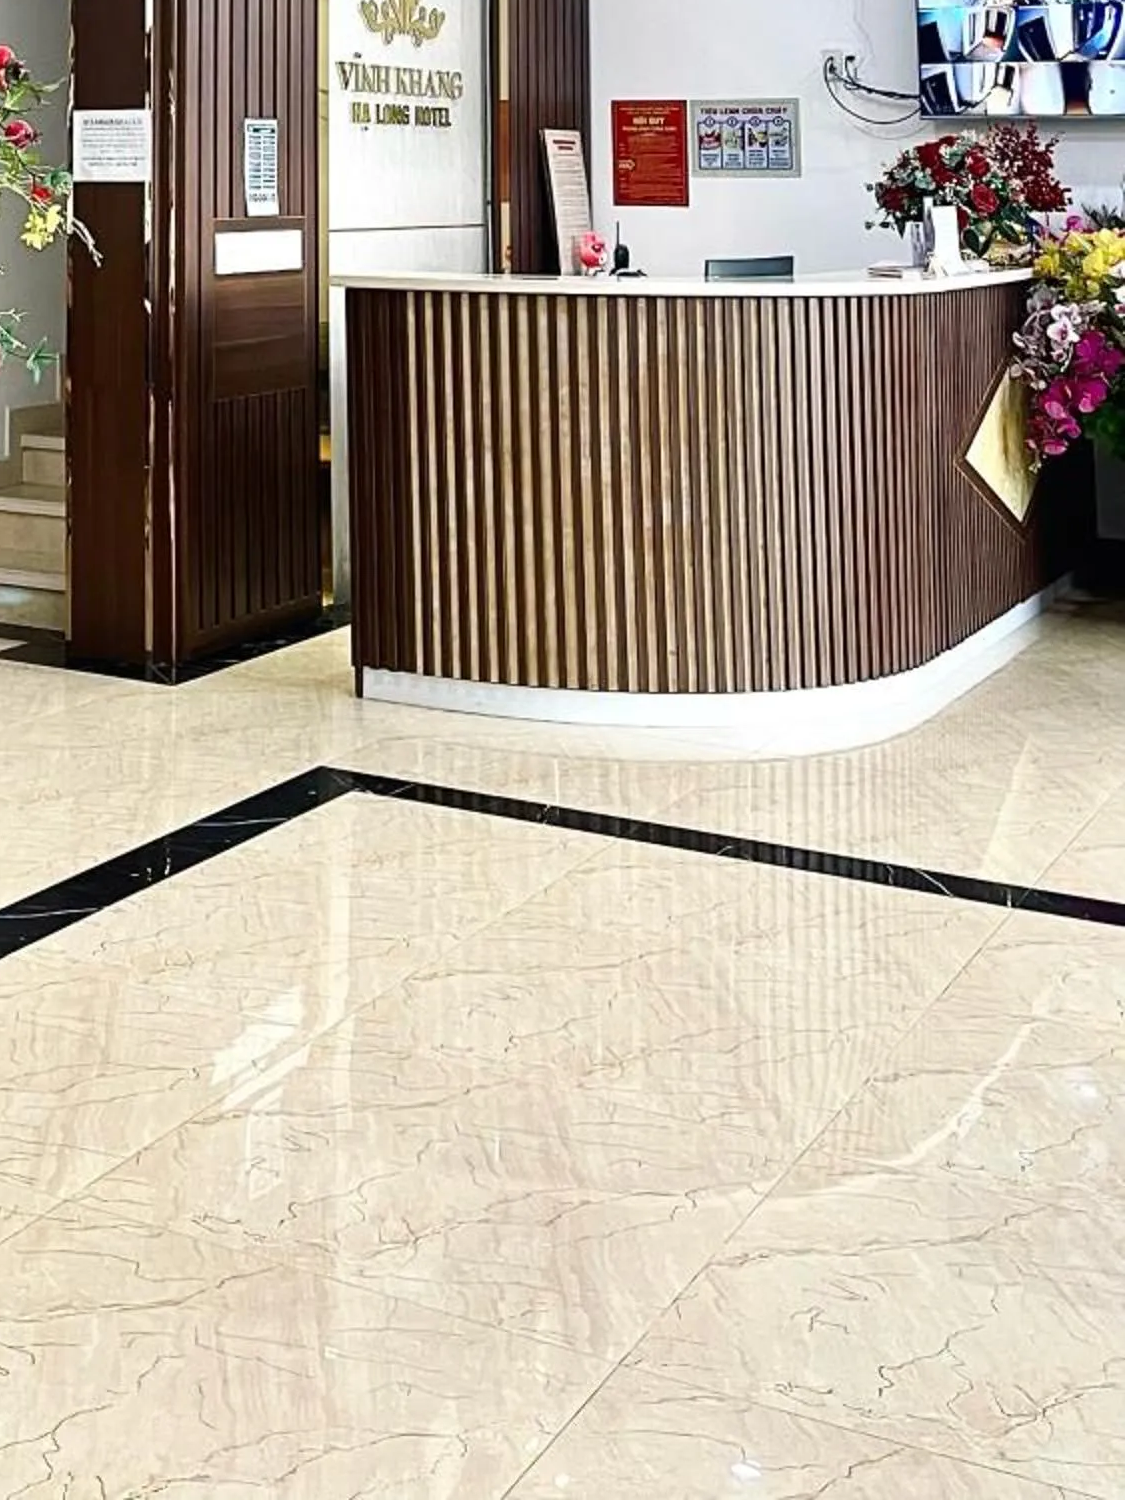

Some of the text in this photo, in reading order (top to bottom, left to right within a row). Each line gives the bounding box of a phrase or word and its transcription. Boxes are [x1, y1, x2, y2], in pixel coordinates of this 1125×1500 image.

[395, 67, 464, 100] KHANG
[375, 103, 410, 125] LONG
[415, 105, 452, 127] HOTEL
